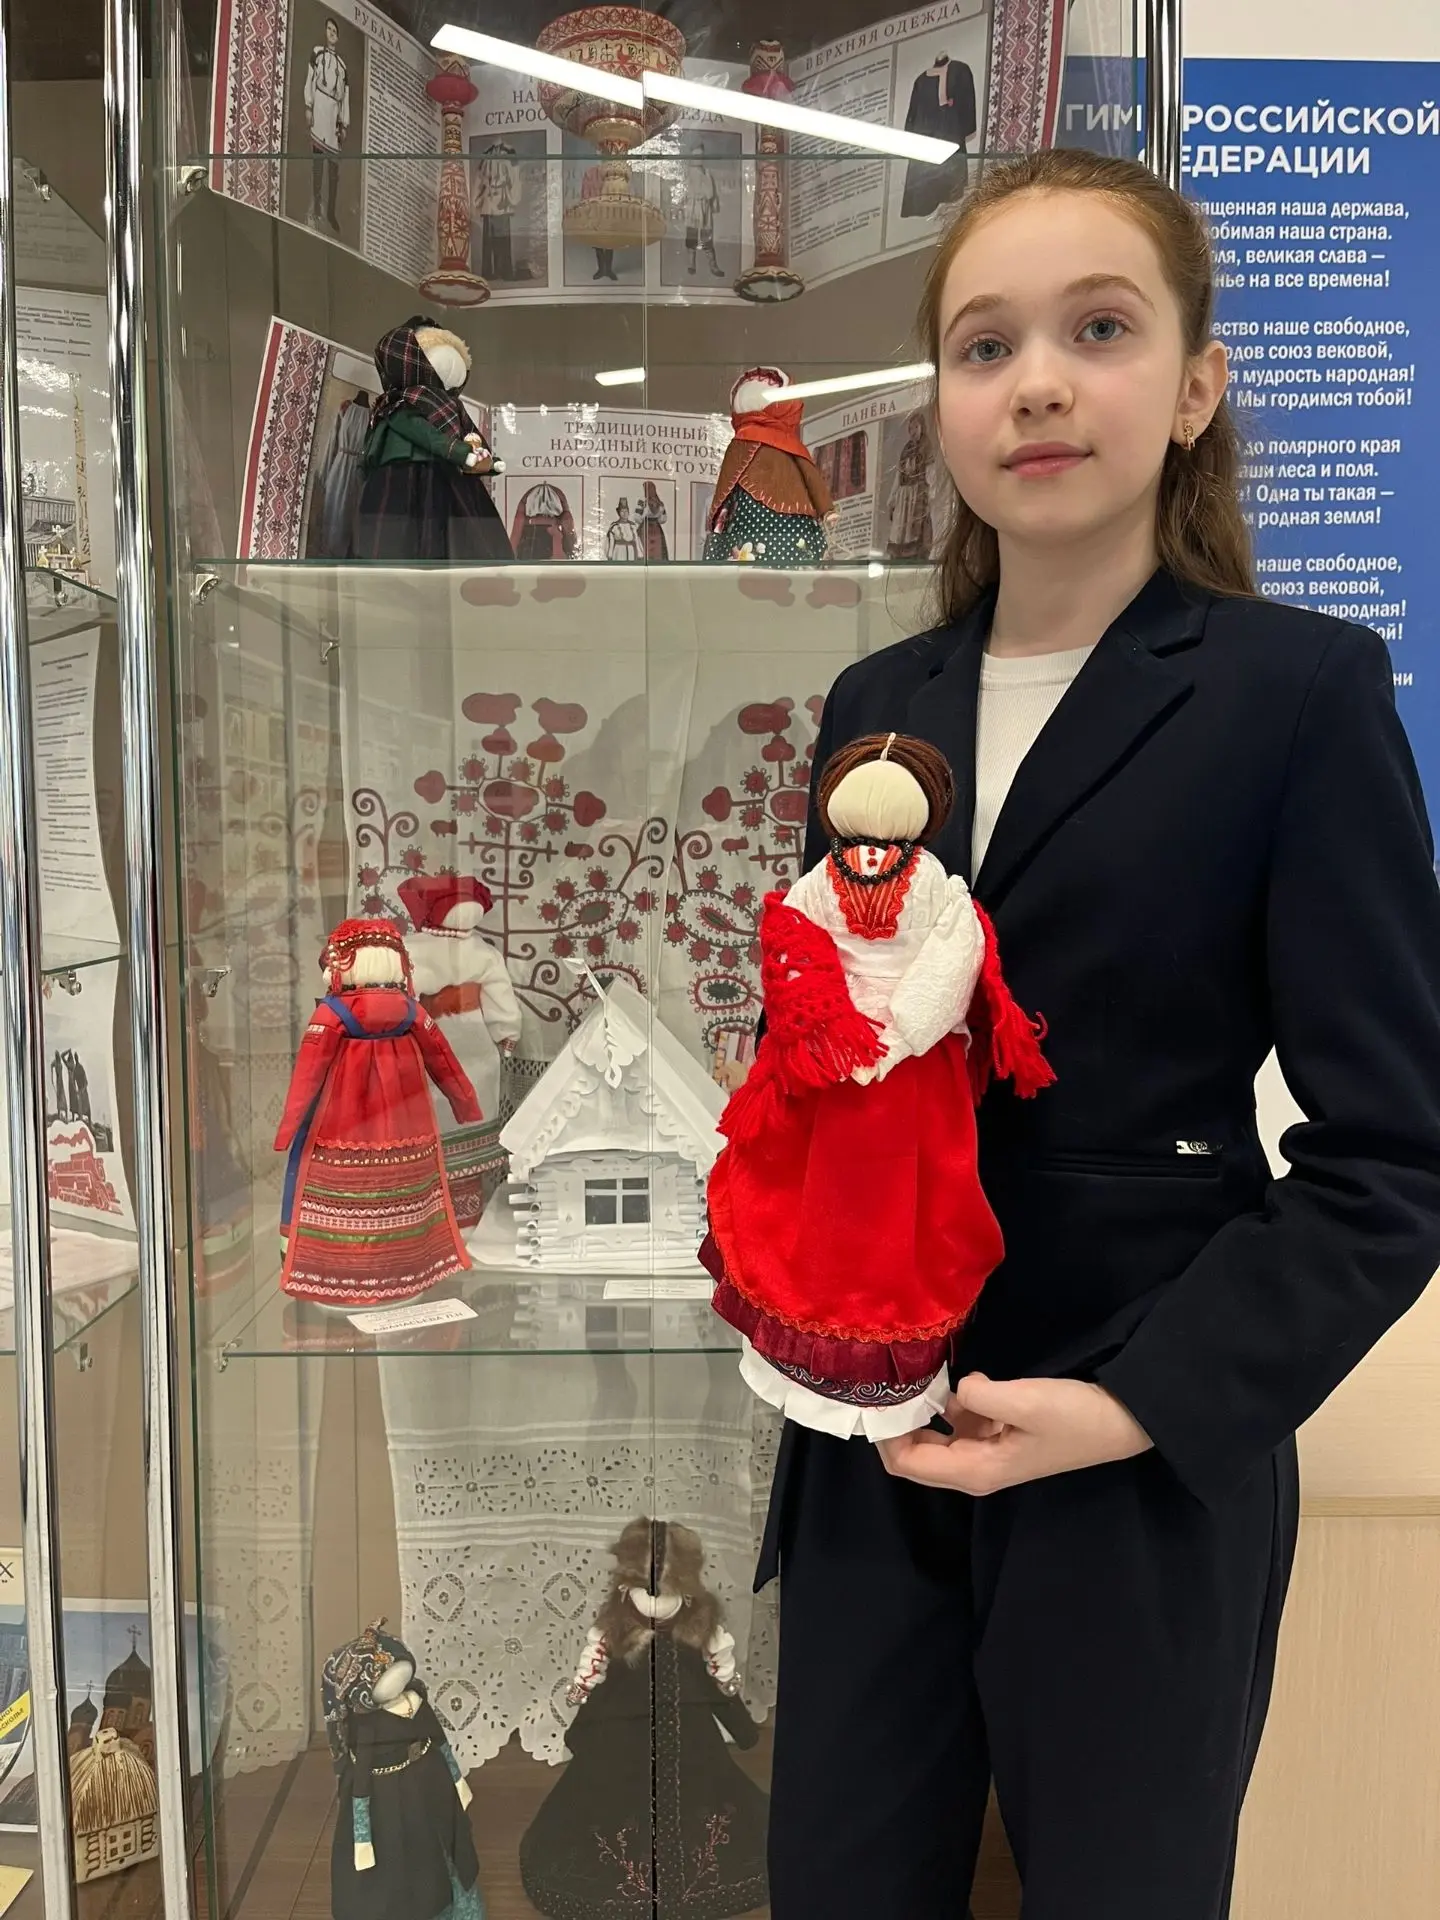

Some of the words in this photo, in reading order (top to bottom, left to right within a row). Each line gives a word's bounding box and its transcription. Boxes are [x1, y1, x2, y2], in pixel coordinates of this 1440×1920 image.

[354, 6, 402, 53] РУБАХА
[805, 29, 878, 71] ВЕРХНЯЯ
[884, 2, 961, 37] ОДЕЖДА
[1183, 99, 1440, 136] РОССИЙСКОЙ
[1138, 145, 1370, 179] ЕДЕРАЦИИ
[1281, 202, 1326, 216] наша
[1331, 202, 1410, 220] держава,
[1279, 225, 1325, 240] наша
[1329, 225, 1392, 244] страна.
[1246, 250, 1314, 263] великая
[1319, 250, 1367, 263] слава
[1214, 273, 1245, 288] нье
[1249, 273, 1270, 288] на
[1274, 273, 1304, 287] все
[1308, 270, 1390, 291] времена!
[1209, 321, 1259, 336] ество
[1263, 321, 1309, 335] наше
[1313, 316, 1410, 337] свободное,
[1268, 344, 1312, 359] союз
[1316, 341, 1393, 361] вековой,
[1243, 368, 1322, 387] мудрость
[1325, 364, 1415, 386] народная!
[1237, 390, 1266, 407] Мы
[1270, 391, 1352, 410] гордимся
[1356, 387, 1412, 406] тобой!
[564, 421, 708, 441] ТРАДИЦИОННЫЙ
[551, 438, 646, 454] НАРОДНЫЙ
[1268, 440, 1356, 458] полярного
[1360, 439, 1400, 456] края
[522, 455, 695, 474] СТАРООСКОЛЬСКОГО
[1277, 463, 1316, 478] леса
[1321, 464, 1331, 478] и
[1335, 463, 1379, 478] поля.
[1256, 484, 1300, 504] Одна
[1303, 487, 1324, 501] ты
[1328, 486, 1376, 501] такая
[1258, 510, 1320, 529] родная
[1324, 506, 1381, 525] земля!
[1256, 558, 1302, 573] наше
[1306, 553, 1402, 574] свободное,
[1261, 580, 1304, 596] союз
[1309, 577, 1385, 597] вековой,
[1317, 600, 1406, 620] народная!
